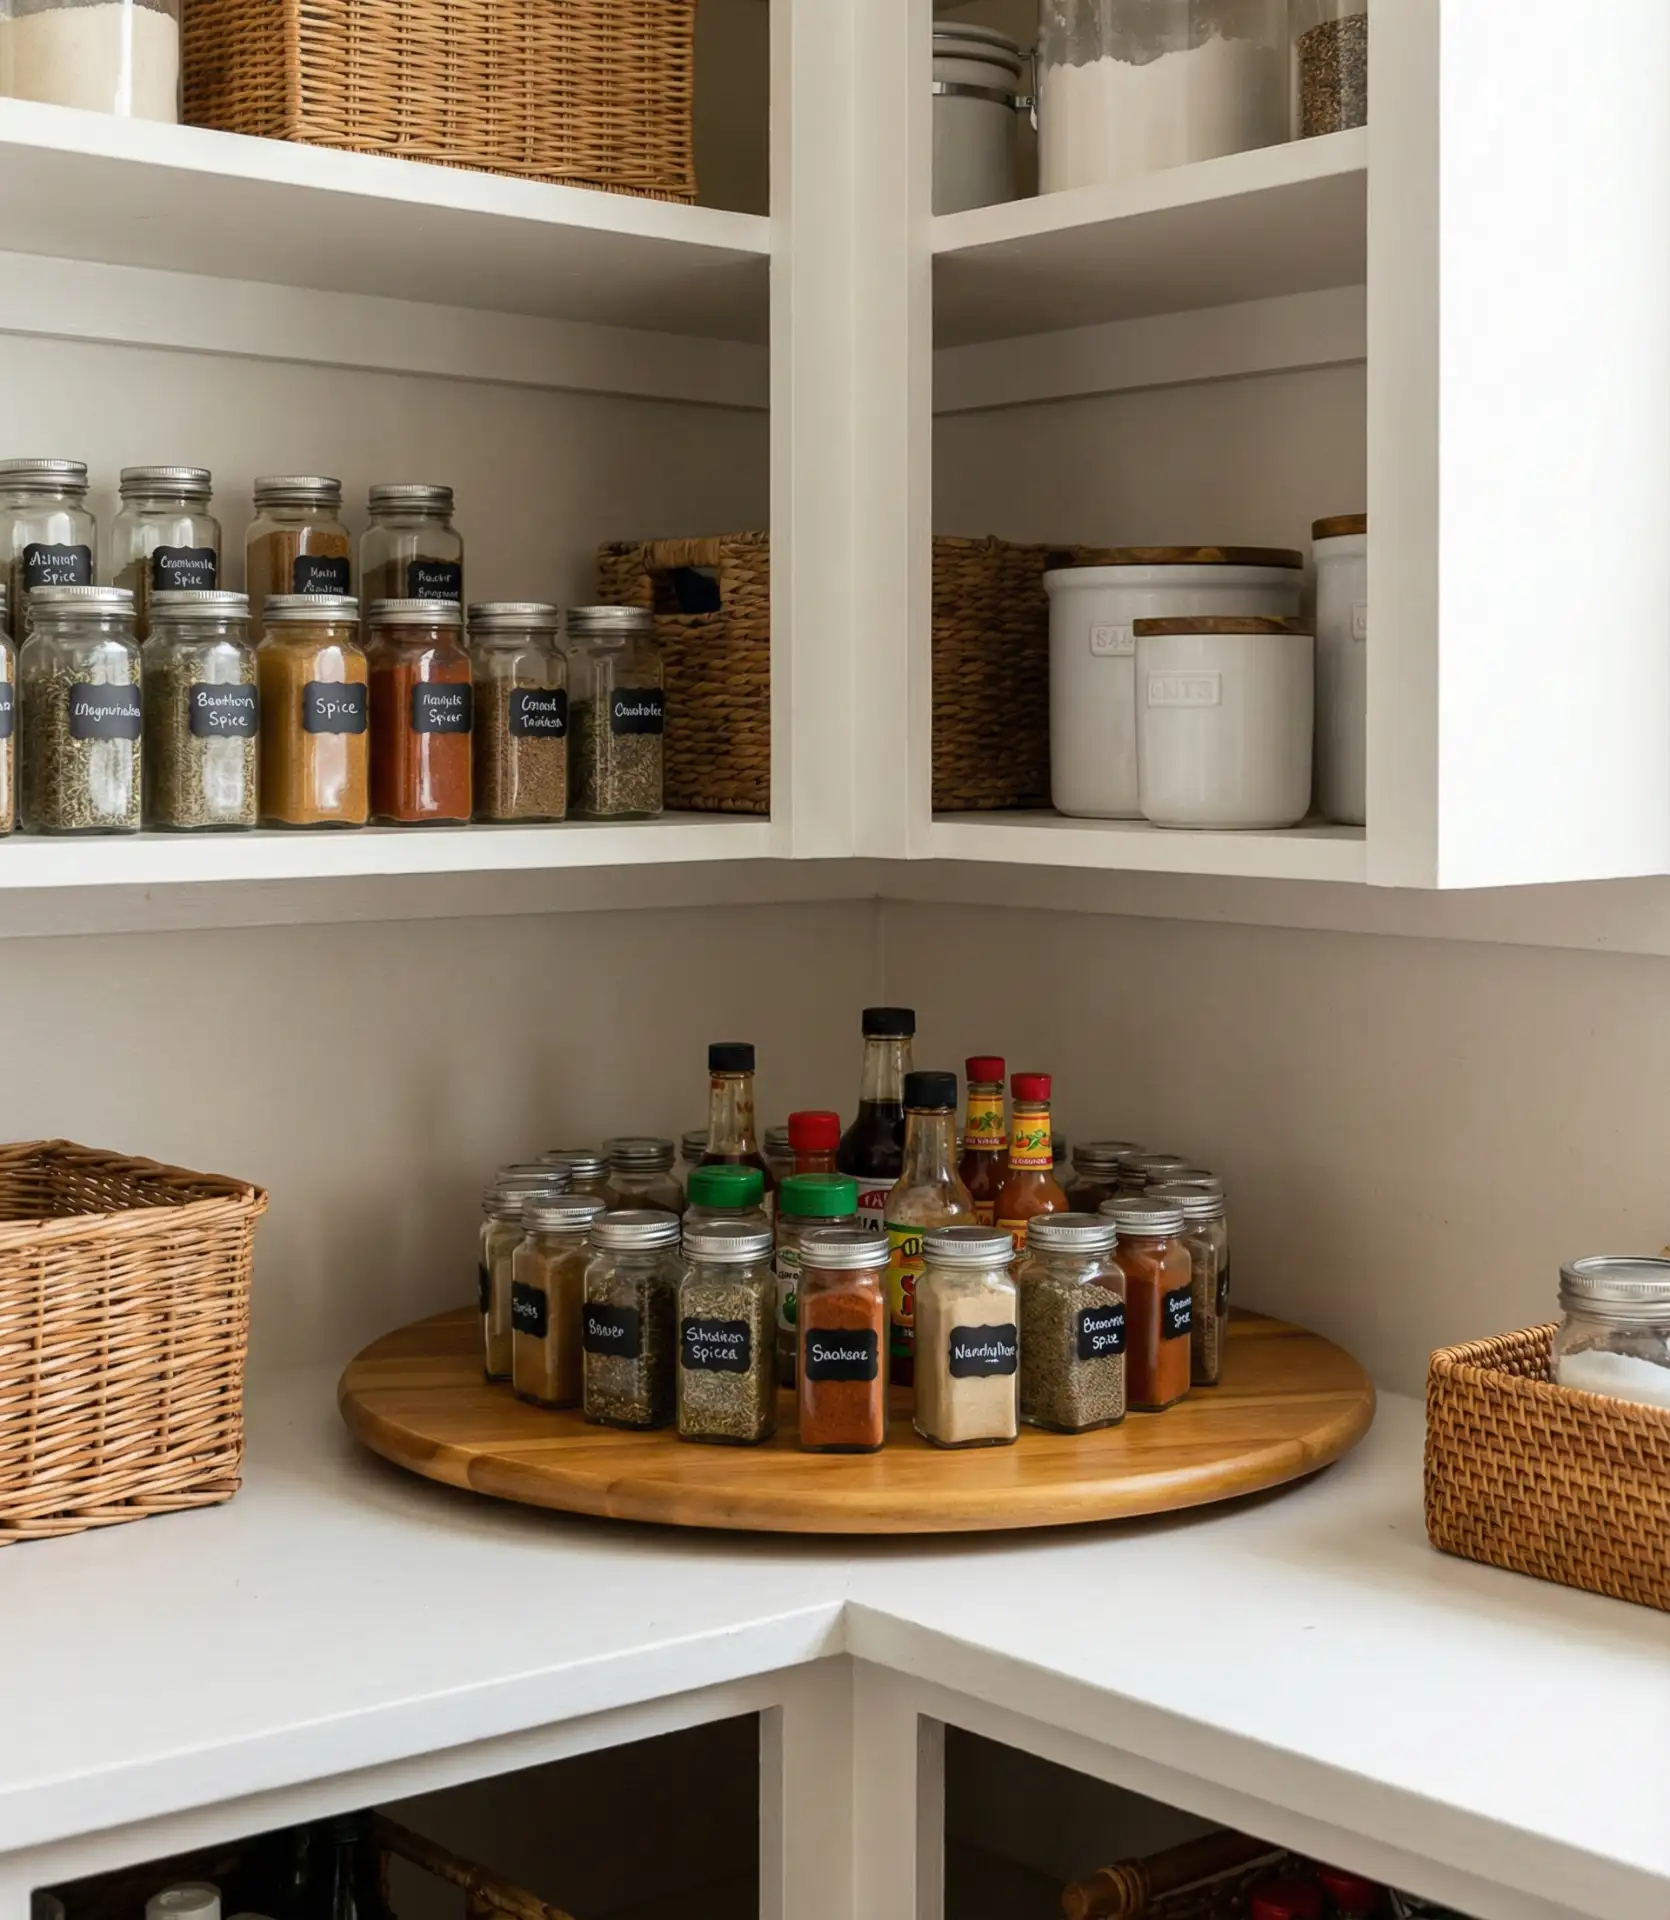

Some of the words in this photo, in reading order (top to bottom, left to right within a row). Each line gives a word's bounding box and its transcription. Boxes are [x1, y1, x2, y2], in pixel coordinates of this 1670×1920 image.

[42, 570, 77, 585] Spice
[315, 697, 359, 720] Spice
[208, 711, 249, 729] Spice
